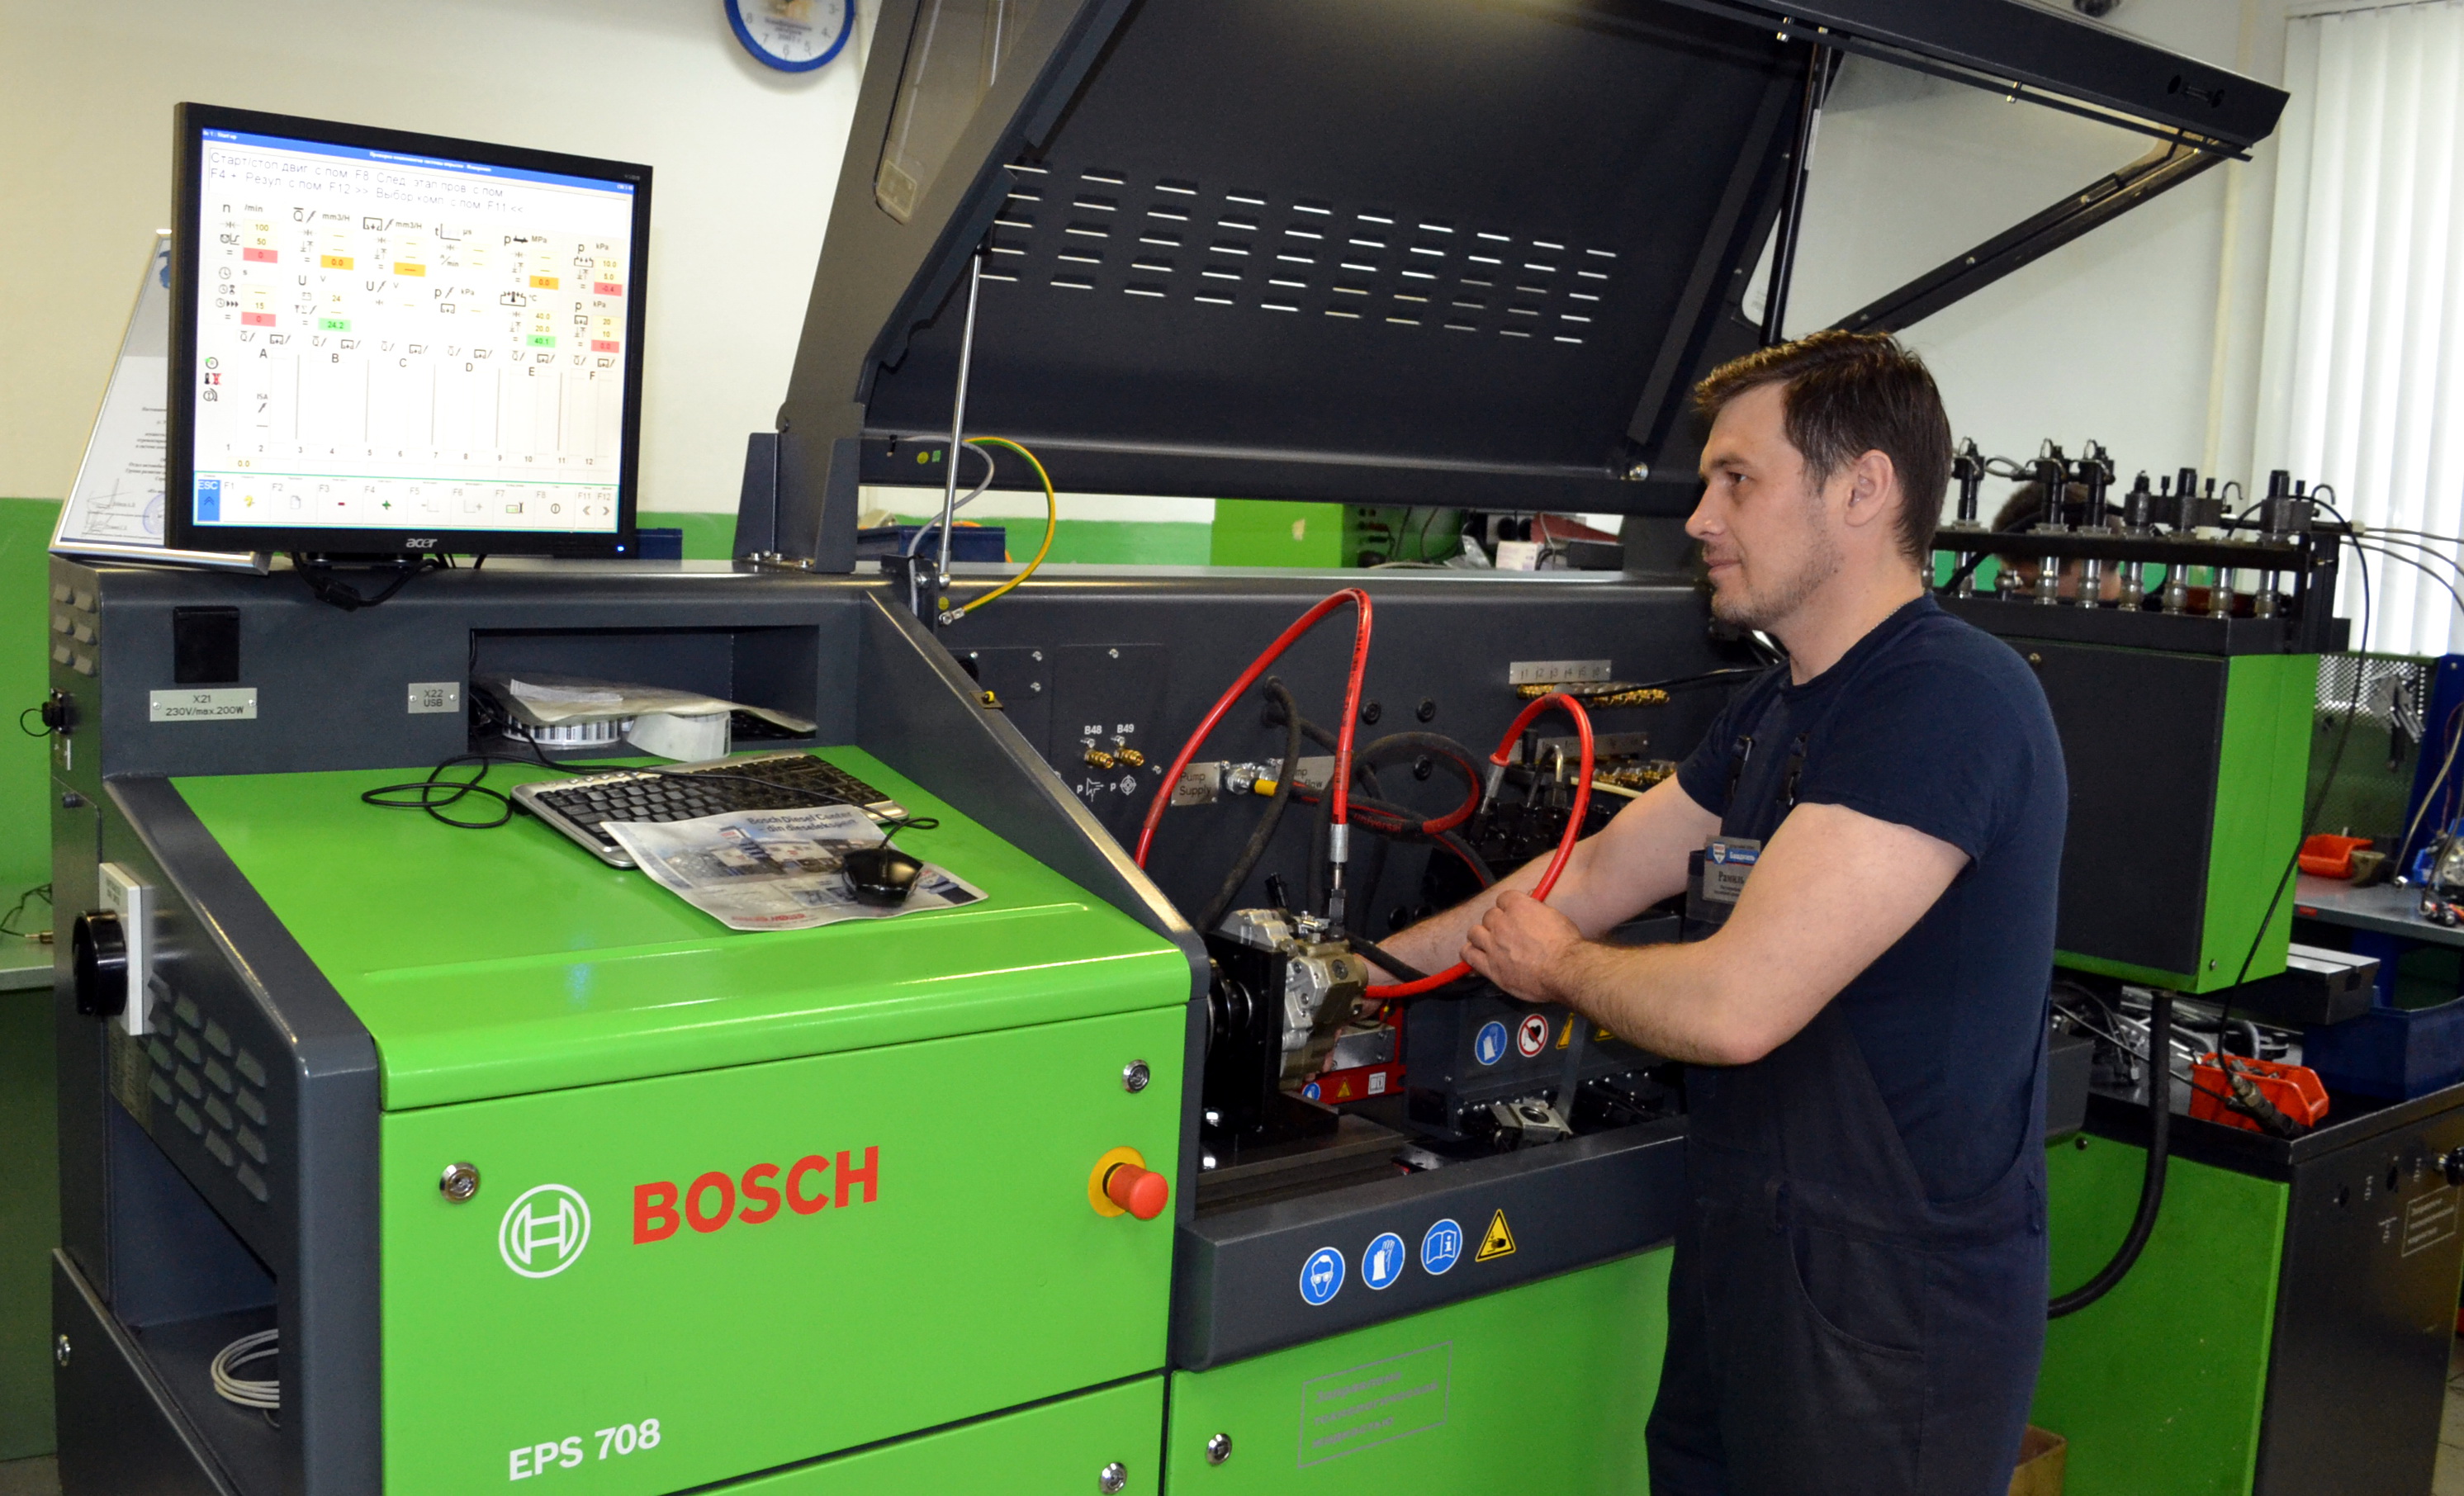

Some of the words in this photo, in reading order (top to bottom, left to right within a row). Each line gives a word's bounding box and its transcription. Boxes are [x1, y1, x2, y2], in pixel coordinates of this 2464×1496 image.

[211, 152, 278, 169] Старт/стоп
[355, 169, 369, 181] F8
[414, 178, 438, 189] этап
[211, 168, 225, 178] F4
[329, 182, 350, 195] F12
[376, 187, 414, 202] Выбор
[487, 201, 506, 212] F11
[244, 204, 263, 213] /min
[322, 213, 350, 222] mm3/H
[254, 223, 269, 232] 100
[395, 220, 422, 230] mm3/H
[257, 237, 267, 246] 50
[531, 235, 547, 244] MPa
[595, 243, 609, 251] kPa
[331, 258, 344, 267] 0.0
[603, 260, 617, 268] 10.0
[461, 288, 475, 296] kPa
[332, 294, 341, 303] 24
[255, 301, 264, 310] 15
[593, 300, 606, 309] kPa
[535, 312, 550, 320] 40.0
[327, 320, 344, 329] 24.2
[535, 324, 550, 333] 20.0
[533, 337, 549, 345] 40.1
[258, 348, 268, 359] A
[331, 353, 339, 363] B
[399, 357, 407, 367] C
[466, 362, 473, 372] D
[528, 367, 535, 376] E
[590, 371, 595, 381] F
[585, 457, 594, 466] 12
[198, 481, 218, 490] ESC
[224, 481, 235, 490] F1
[272, 483, 283, 492] F2
[319, 484, 329, 493] F3
[364, 485, 375, 494] F4
[410, 486, 419, 495] F5
[453, 487, 463, 496] F6
[495, 489, 505, 498] F7
[536, 490, 547, 499] F8
[577, 491, 591, 500] F11
[597, 492, 611, 501] F12
[405, 537, 438, 548] acer
[424, 689, 443, 698] X22
[192, 694, 211, 703] X21
[424, 698, 443, 708] USB
[165, 706, 244, 716] 230V/max.200W
[1084, 725, 1102, 735] B48
[1116, 723, 1135, 734] B49
[1180, 771, 1206, 784] Pump
[1179, 784, 1211, 798] Supply
[747, 816, 780, 825] Bosch
[781, 814, 816, 823] Diesel
[816, 812, 852, 821] Center
[633, 1145, 879, 1245] BOSCH
[509, 1436, 584, 1482] EPS
[594, 1418, 661, 1460] 708
